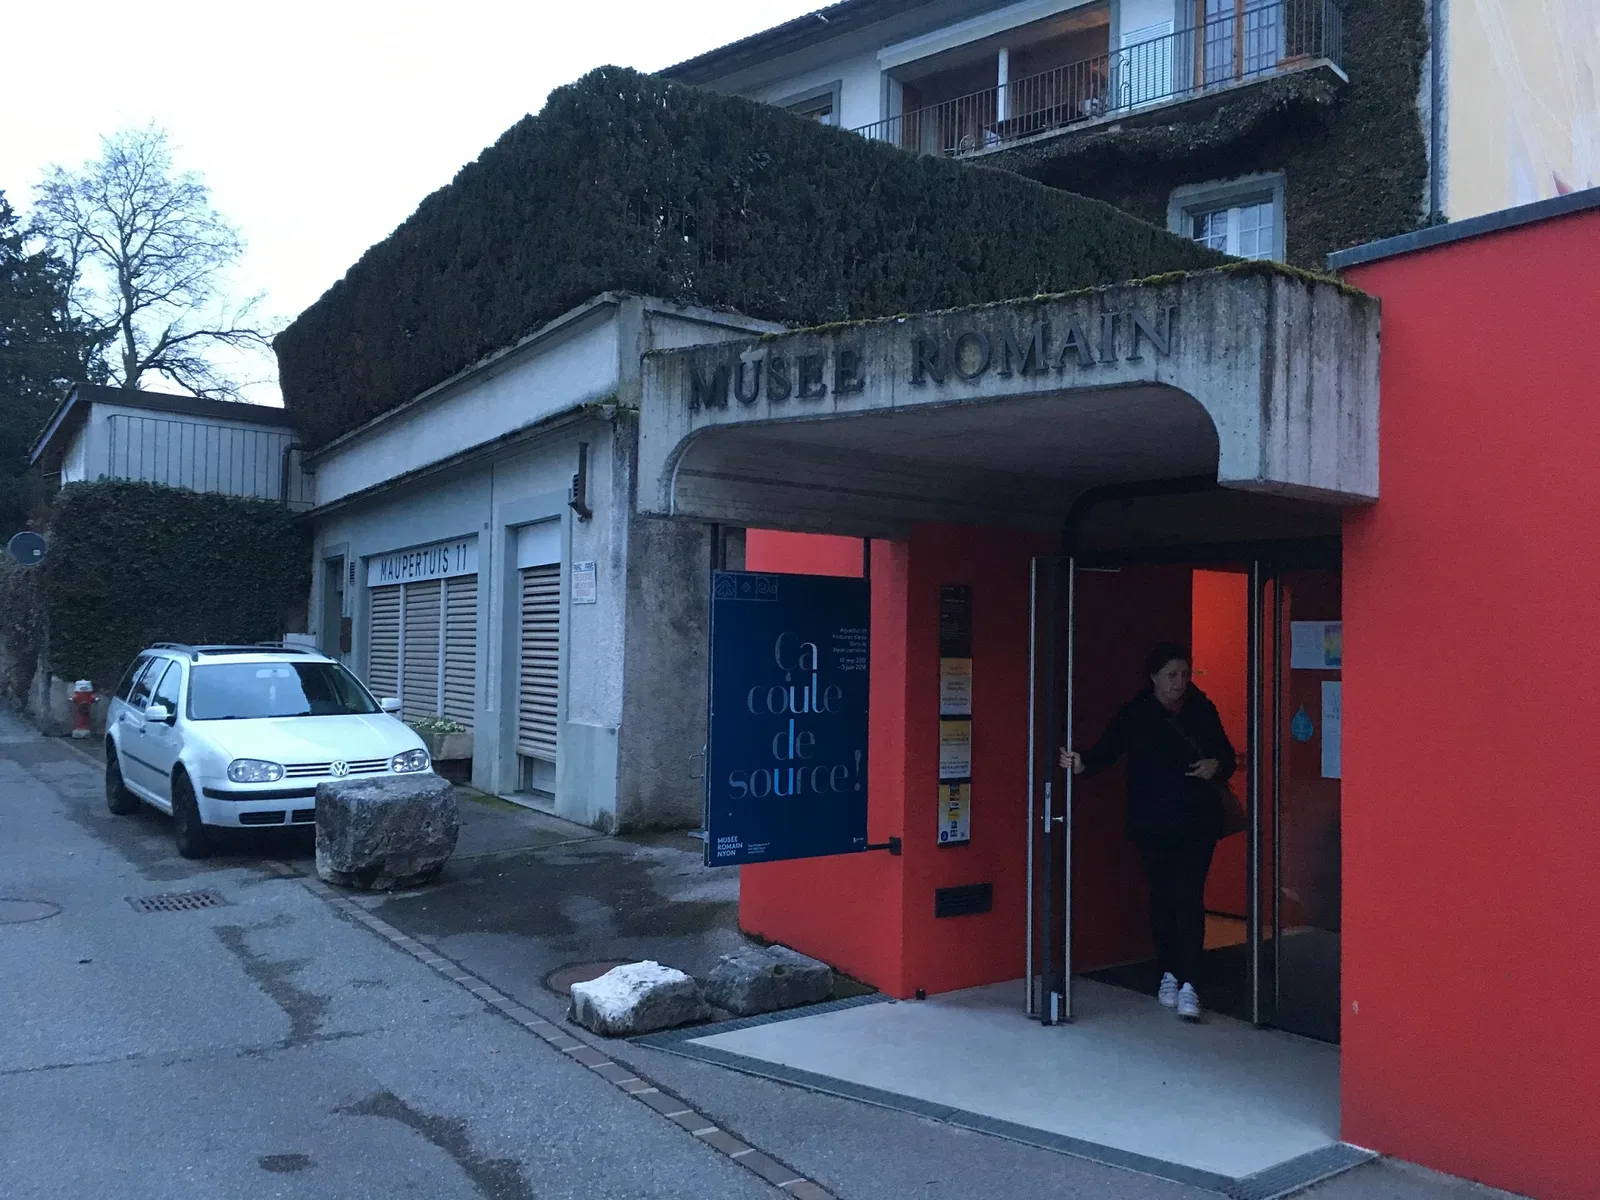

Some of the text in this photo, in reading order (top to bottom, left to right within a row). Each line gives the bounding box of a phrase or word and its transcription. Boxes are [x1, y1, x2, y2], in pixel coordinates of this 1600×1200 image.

[909, 305, 1177, 386] ROMAIN
[380, 543, 467, 582] MAUPERTUIS 11
[774, 631, 818, 682] Ça
[747, 672, 843, 715] coule
[772, 718, 816, 761] de
[717, 842, 743, 851] ROMAIN
[717, 849, 736, 858] NYON
